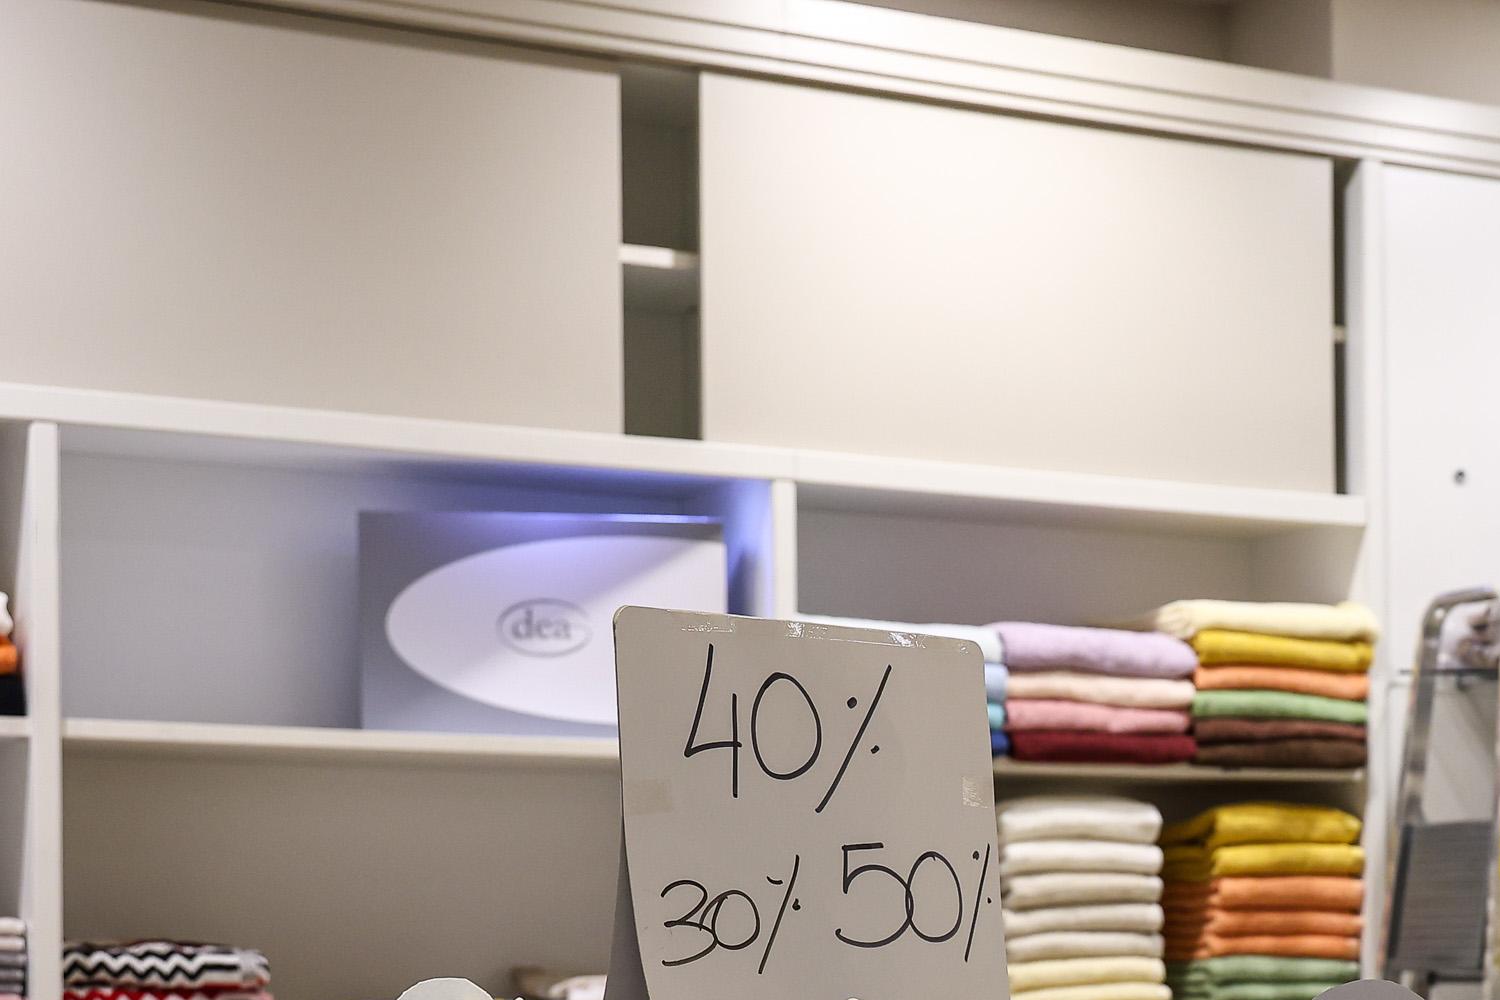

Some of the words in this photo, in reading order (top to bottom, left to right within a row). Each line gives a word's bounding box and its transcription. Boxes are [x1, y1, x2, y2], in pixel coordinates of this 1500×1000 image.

[511, 609, 572, 641] dea
[684, 643, 892, 813] 40%
[661, 854, 801, 974] 30%
[835, 842, 992, 962] 50%
